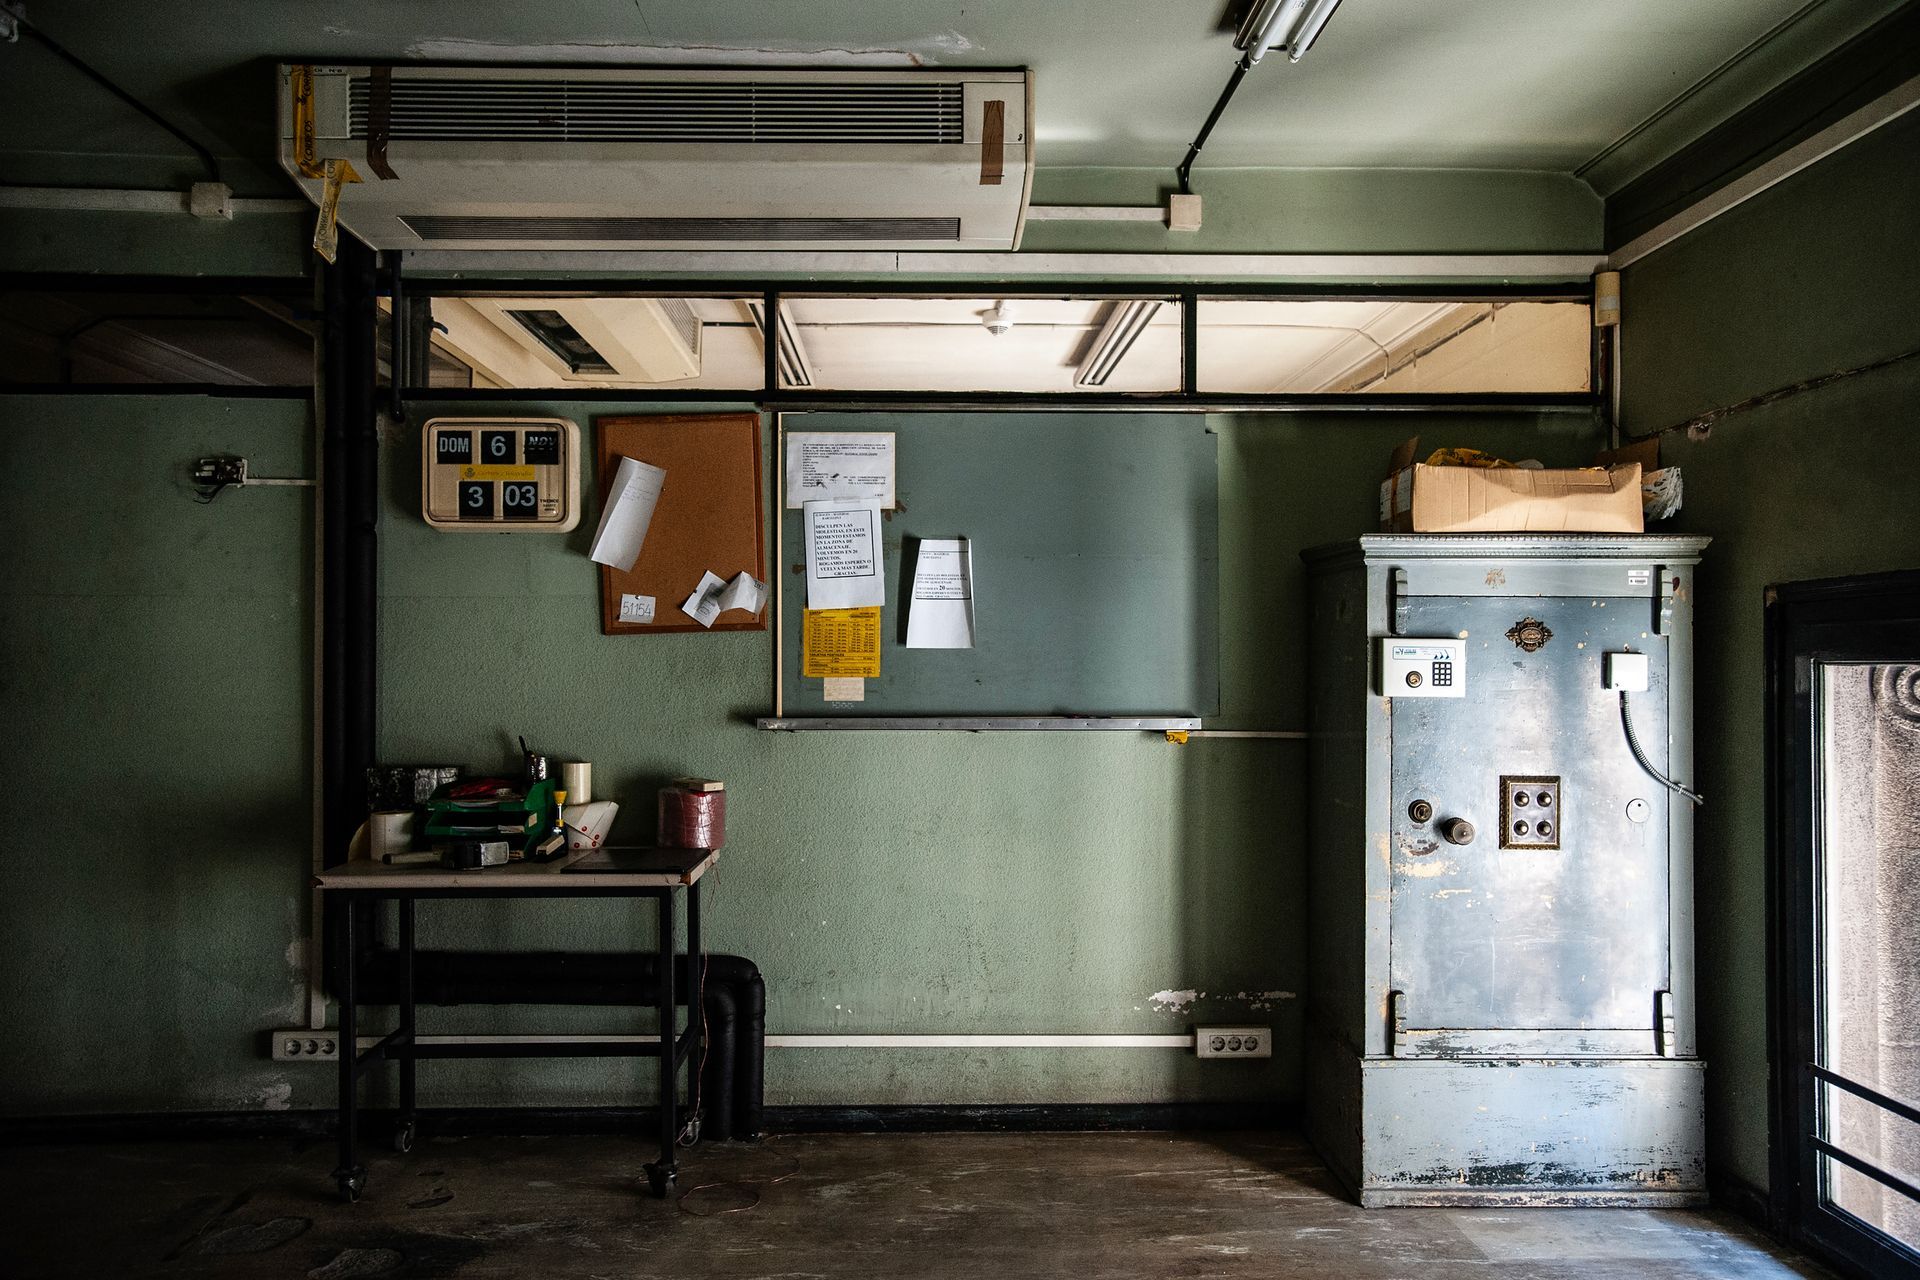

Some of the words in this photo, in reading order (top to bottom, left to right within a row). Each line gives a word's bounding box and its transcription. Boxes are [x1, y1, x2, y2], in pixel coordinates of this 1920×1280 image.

[304, 120, 313, 162] CORREOS
[319, 201, 332, 242] CORREOS
[439, 437, 469, 453] DOM
[491, 436, 506, 456] 6
[468, 486, 484, 508] 3
[505, 485, 536, 507] 03
[623, 601, 651, 617] 51154
